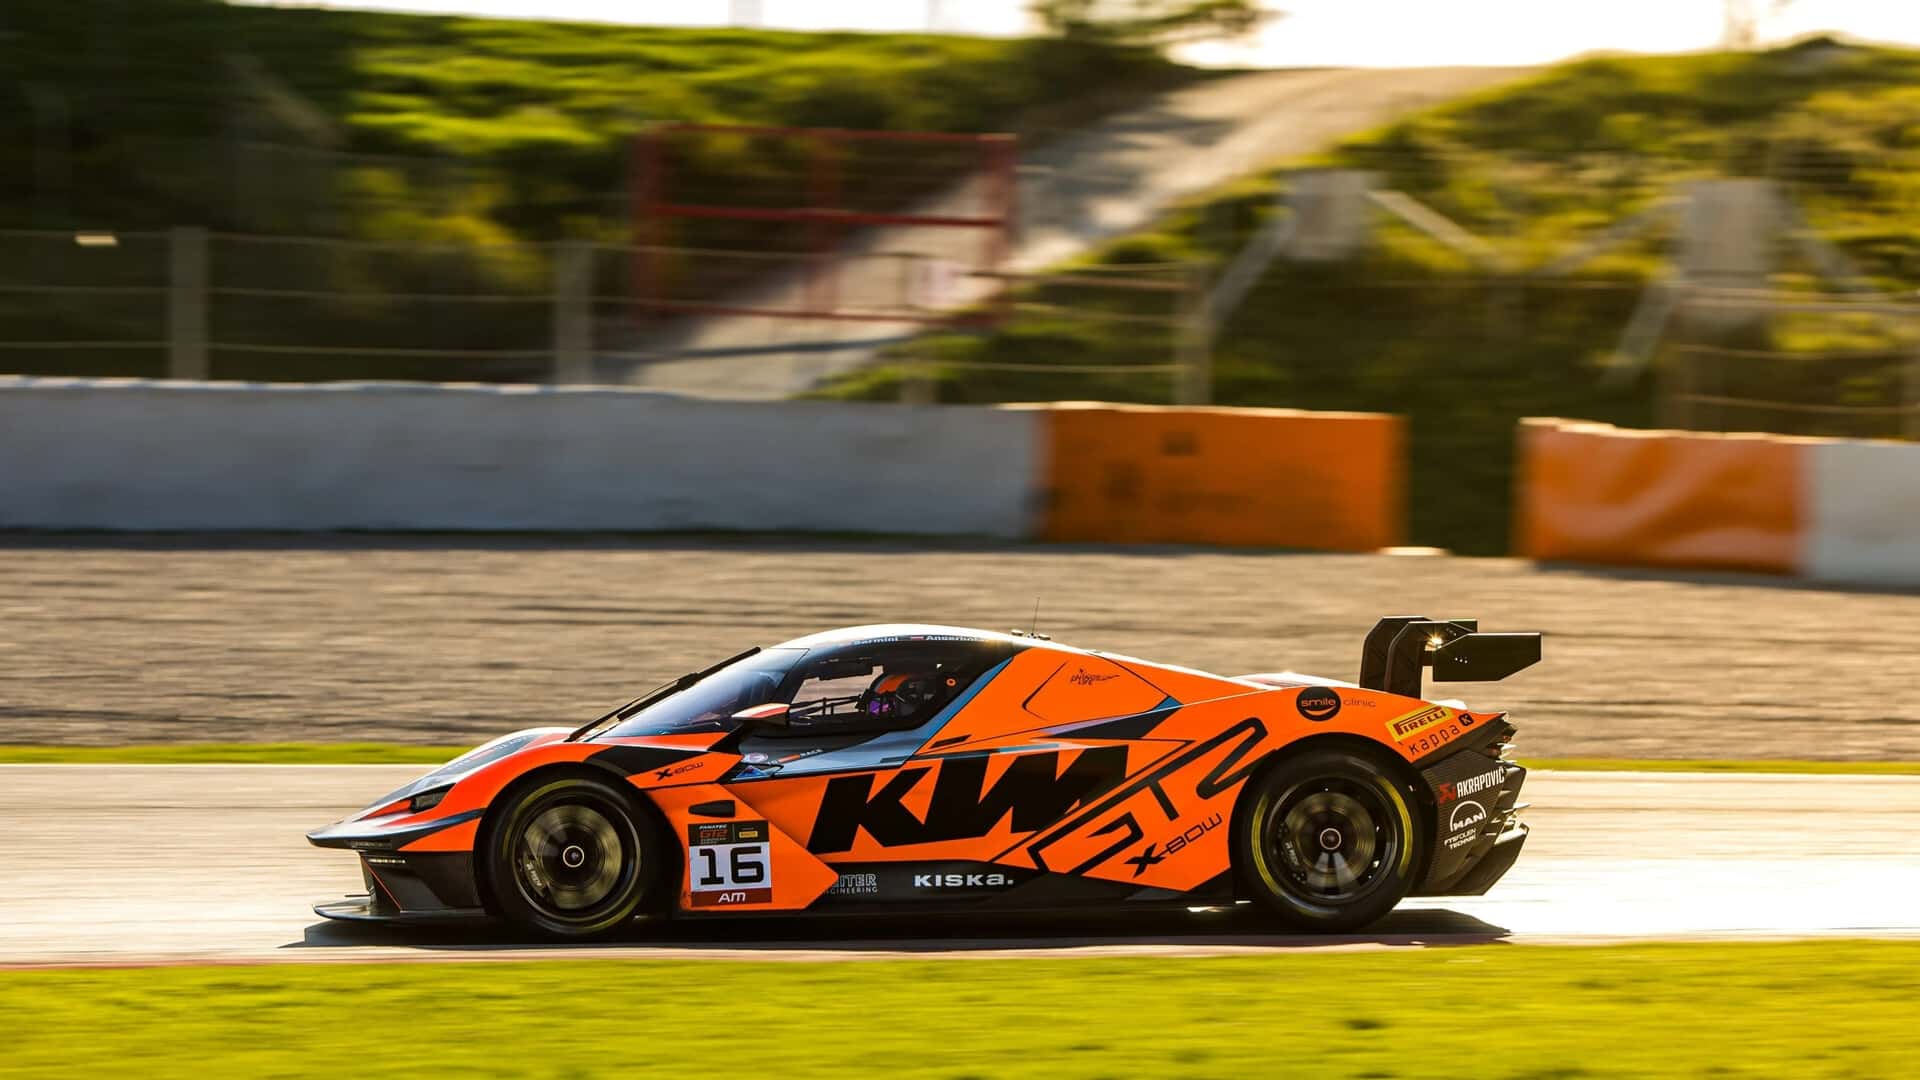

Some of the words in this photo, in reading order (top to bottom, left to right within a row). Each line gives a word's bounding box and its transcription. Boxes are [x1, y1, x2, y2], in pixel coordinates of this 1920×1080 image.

[1300, 697, 1337, 708] smile
[1343, 697, 1377, 708] clinic
[1392, 706, 1447, 736] PIRELLI
[1408, 724, 1461, 756] kappa
[806, 745, 1129, 855] KTM
[1453, 812, 1484, 831] MAN
[699, 846, 765, 886] 16
[825, 887, 878, 895] GINEERING
[833, 874, 877, 887] ITER
